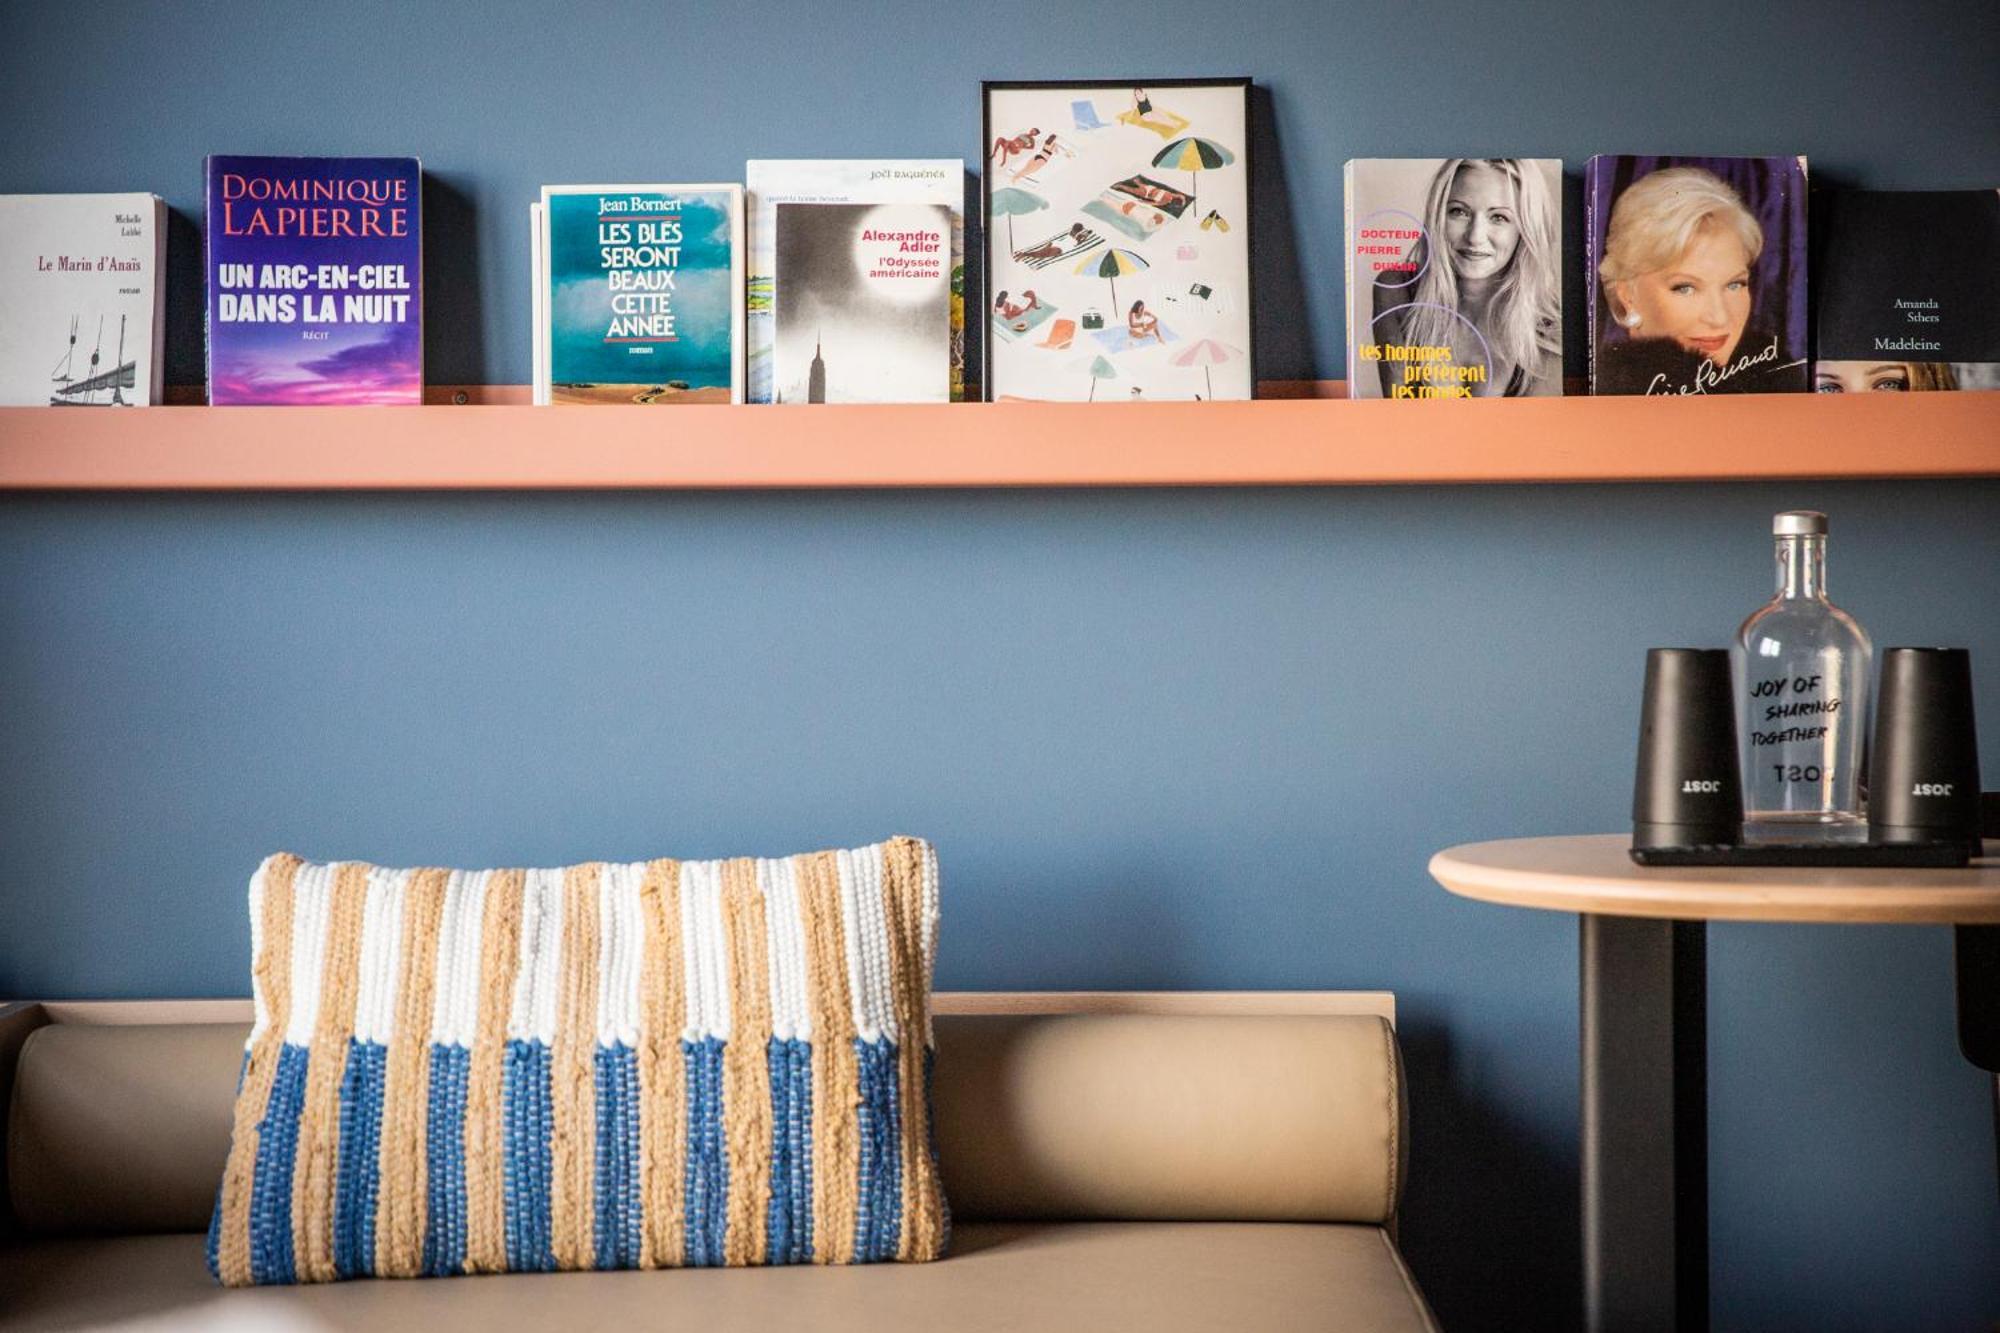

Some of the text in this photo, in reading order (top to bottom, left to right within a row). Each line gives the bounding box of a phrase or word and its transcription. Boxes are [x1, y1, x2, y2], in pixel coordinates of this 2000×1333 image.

[223, 173, 407, 206] DOMINIQUE
[597, 197, 682, 216] Jean Bornert
[224, 202, 408, 237] LAPIERRE
[599, 220, 683, 246] LES BLÉS
[862, 229, 940, 242] Alexandre
[1361, 229, 1421, 240] DOCTEUR
[601, 246, 682, 268] SERONT
[899, 241, 940, 254] Adler
[1357, 246, 1402, 256] PIERRE
[38, 256, 142, 272] Le Marin d'Anaïs
[879, 257, 940, 268] l'Odyssée
[219, 263, 411, 290] UN ARC-EN-CIEL
[608, 270, 677, 291] BEAUX
[869, 268, 940, 279] américaine
[219, 294, 411, 323] DANS LA NUIT
[611, 293, 672, 315] CETTE
[1893, 298, 1939, 309] Amanda
[606, 315, 676, 338] ANNÉE
[1906, 311, 1940, 323] Sthers
[1385, 343, 1453, 362] hommes
[1874, 337, 1942, 351] Madeleine
[1404, 362, 1488, 384] préfèrent
[1750, 675, 1822, 698] JOY OF
[1764, 698, 1842, 722] SHARING
[1751, 726, 1829, 747] TOGETHER
[1682, 780, 1722, 793] JOST
[1911, 783, 1953, 796] JOST
